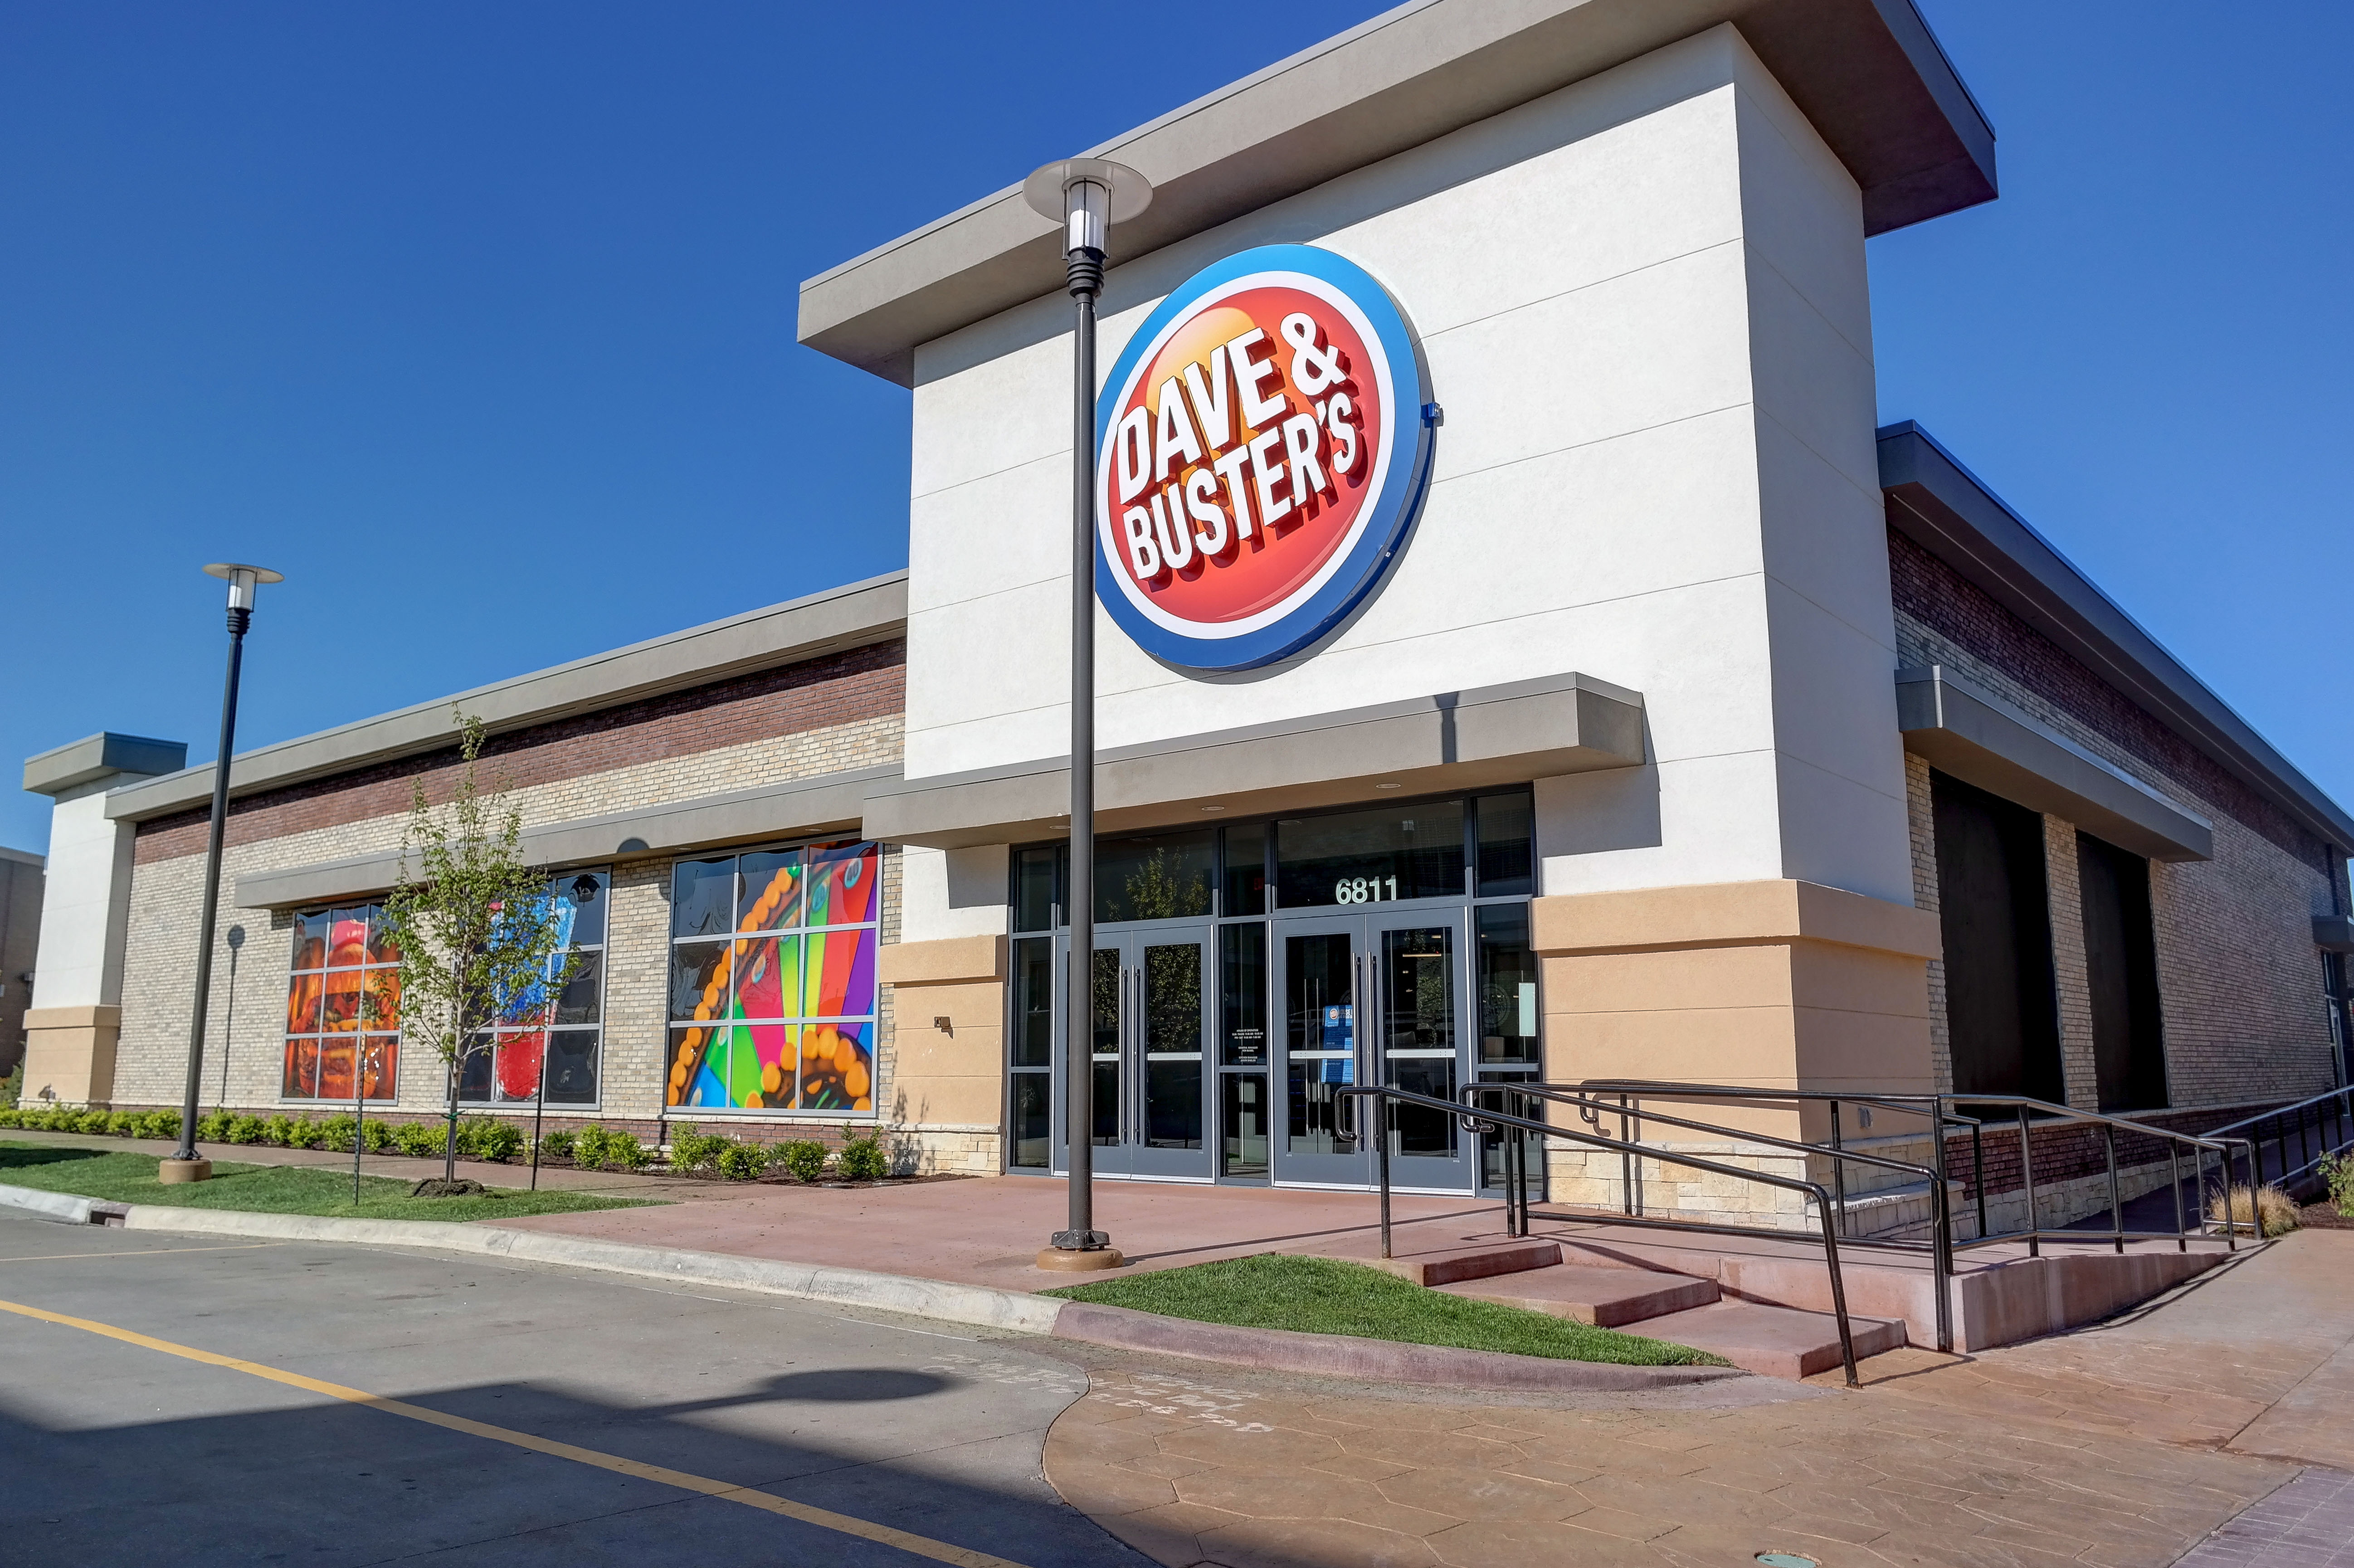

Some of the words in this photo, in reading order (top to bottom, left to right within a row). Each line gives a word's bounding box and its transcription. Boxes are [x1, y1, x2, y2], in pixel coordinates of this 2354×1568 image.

[1117, 327, 1288, 505] DAVE
[1280, 311, 1349, 397] &
[1122, 392, 1359, 580] BUSTER'S
[1336, 874, 1397, 905] 6811
